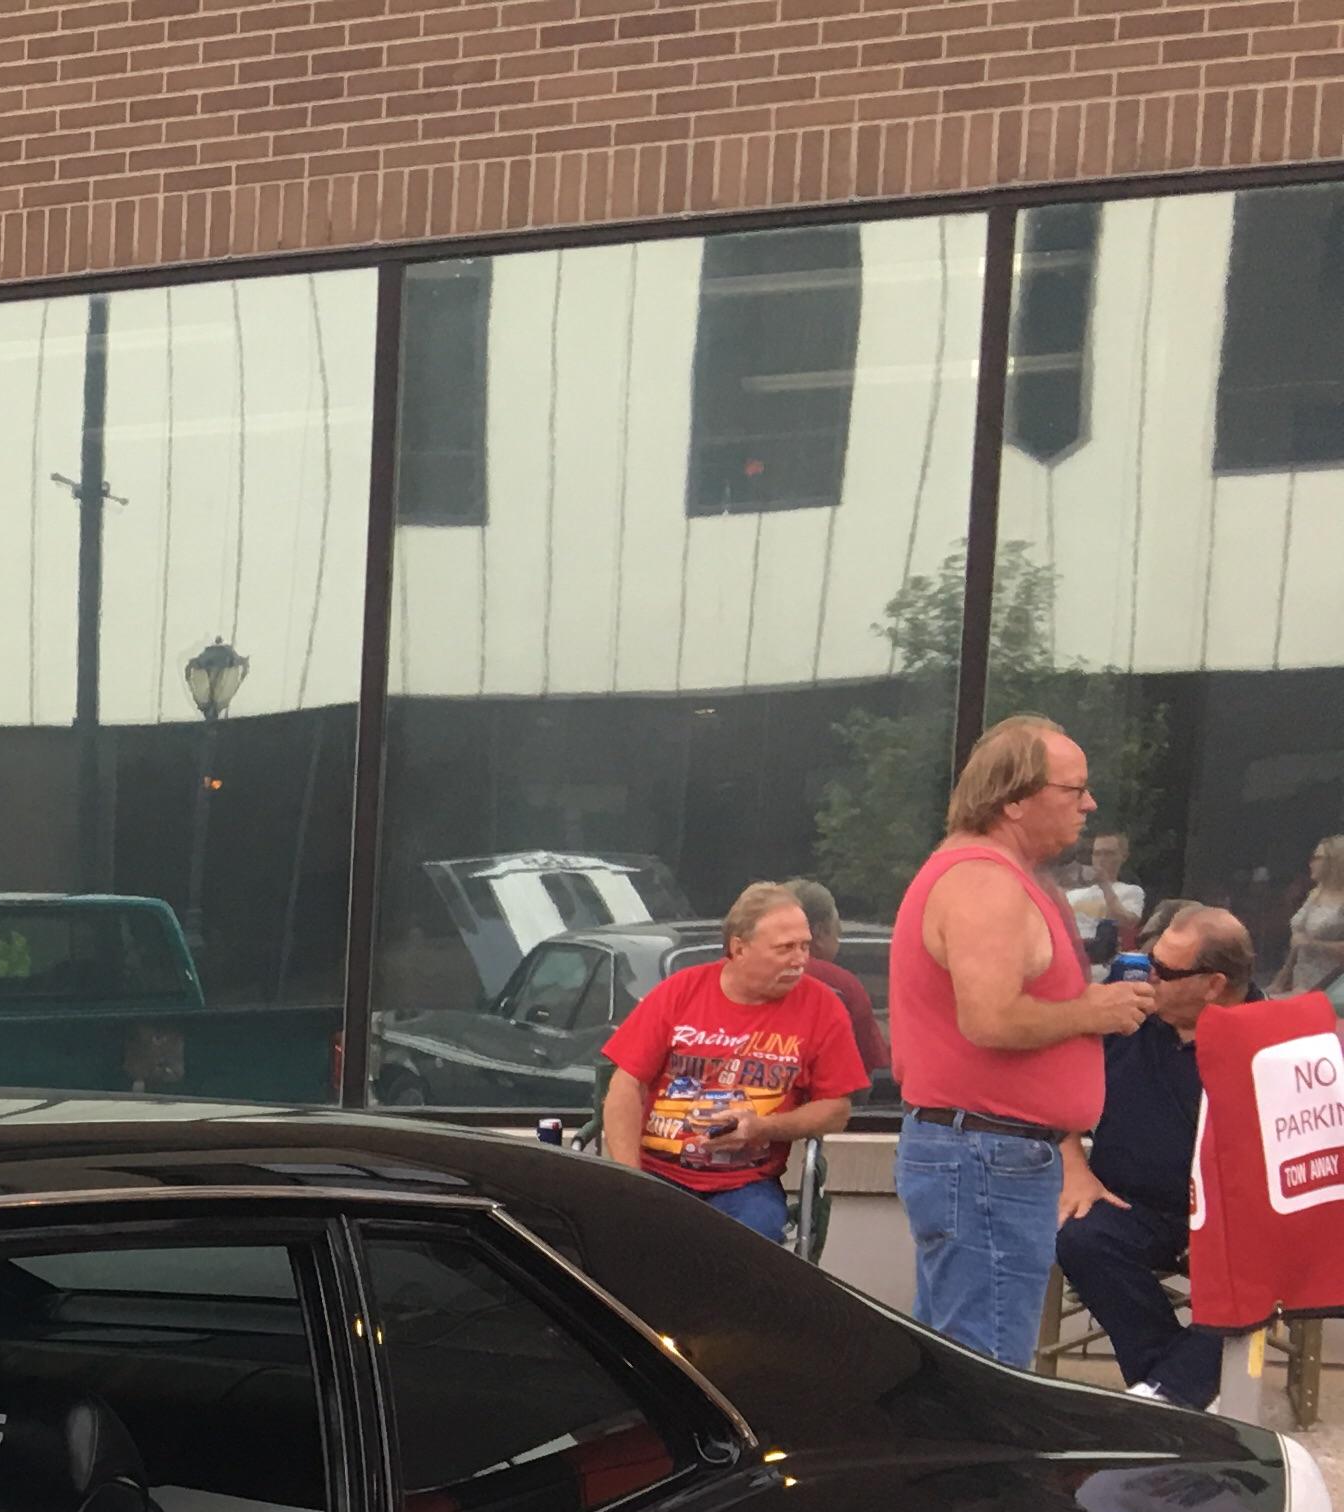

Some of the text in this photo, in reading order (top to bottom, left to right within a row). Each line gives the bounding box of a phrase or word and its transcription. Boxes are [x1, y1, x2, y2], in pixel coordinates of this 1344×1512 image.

[718, 1071, 736, 1085] GO
[739, 1059, 801, 1091] FAST
[1294, 1057, 1337, 1093] NO
[1284, 1154, 1339, 1188] TOW AWAY
